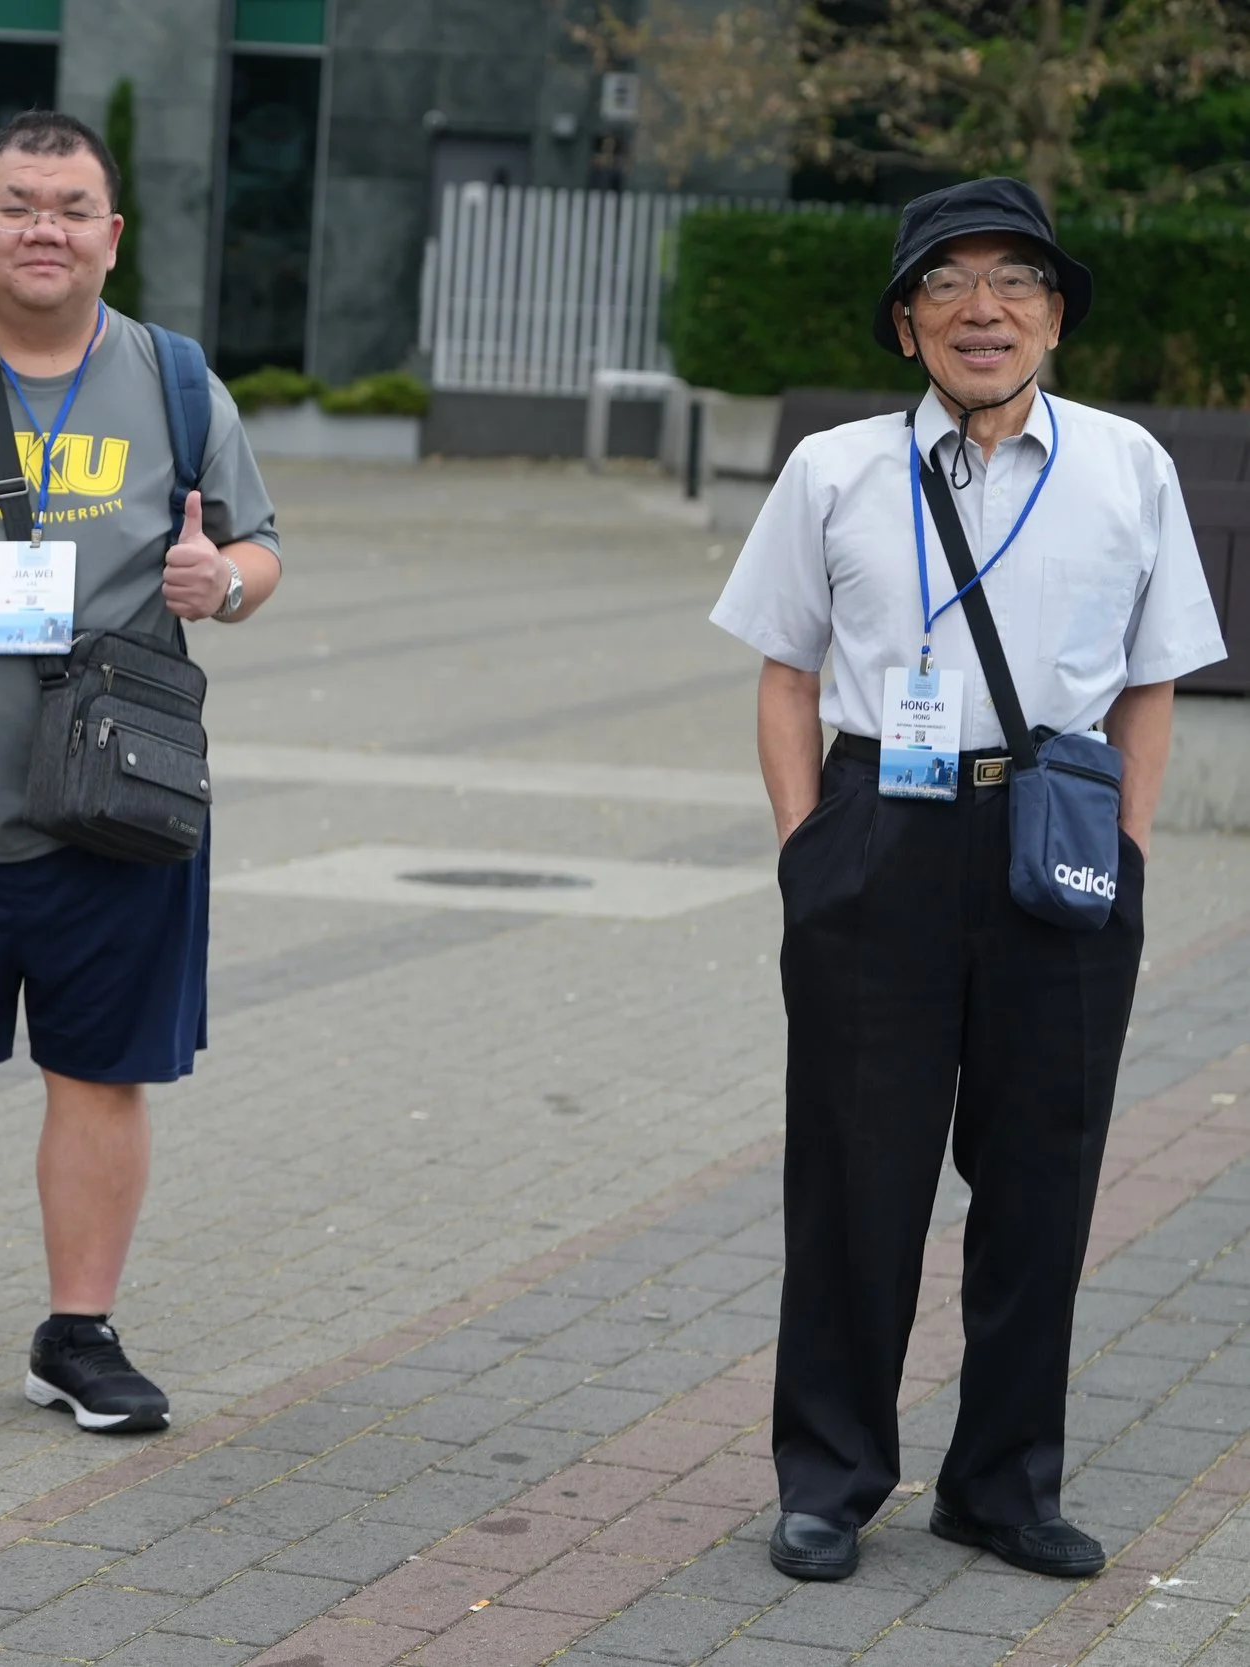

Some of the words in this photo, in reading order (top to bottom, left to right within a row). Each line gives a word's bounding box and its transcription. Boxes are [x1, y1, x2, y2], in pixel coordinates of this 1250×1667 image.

[14, 569, 54, 579] JIA-WEI
[900, 700, 945, 712] HONG-KI
[1054, 863, 1117, 901] adida
